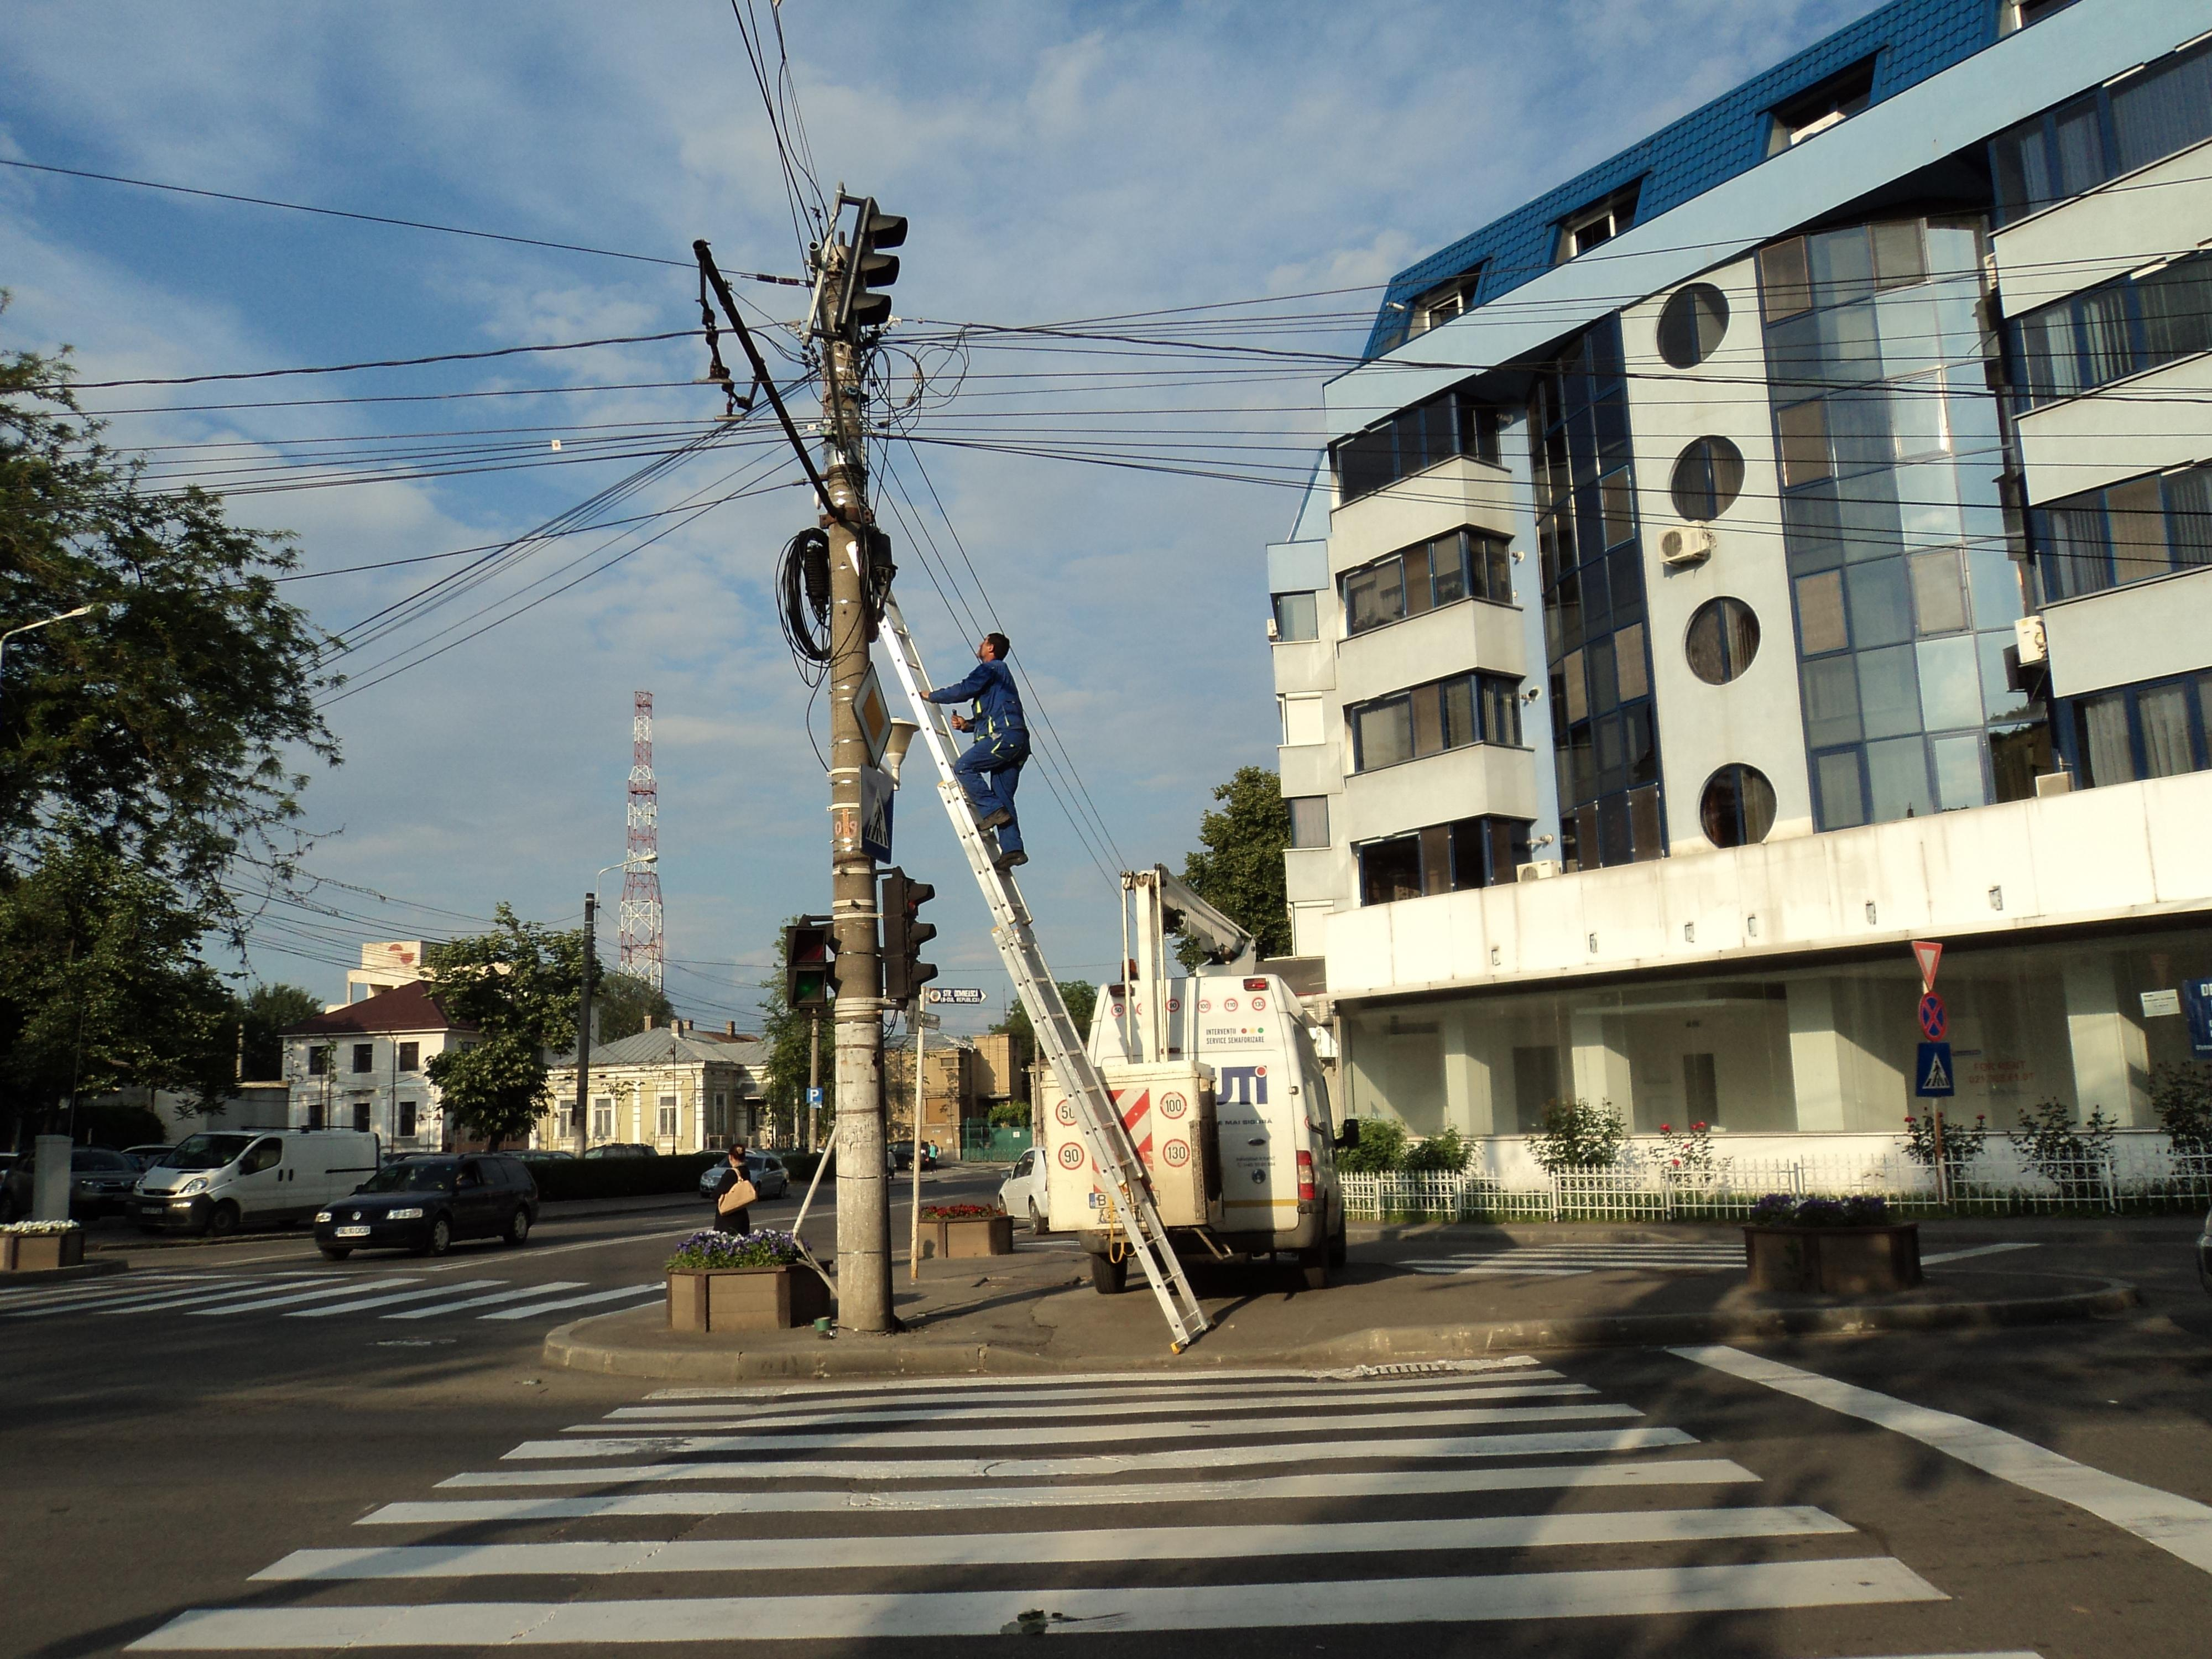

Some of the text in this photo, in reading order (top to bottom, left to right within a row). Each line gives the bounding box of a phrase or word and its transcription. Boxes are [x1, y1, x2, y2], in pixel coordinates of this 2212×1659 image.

[810, 1089, 819, 1102] P
[1166, 1099, 1181, 1112] 100
[1064, 1149, 1078, 1162] 90
[1168, 1146, 1186, 1160] 130
